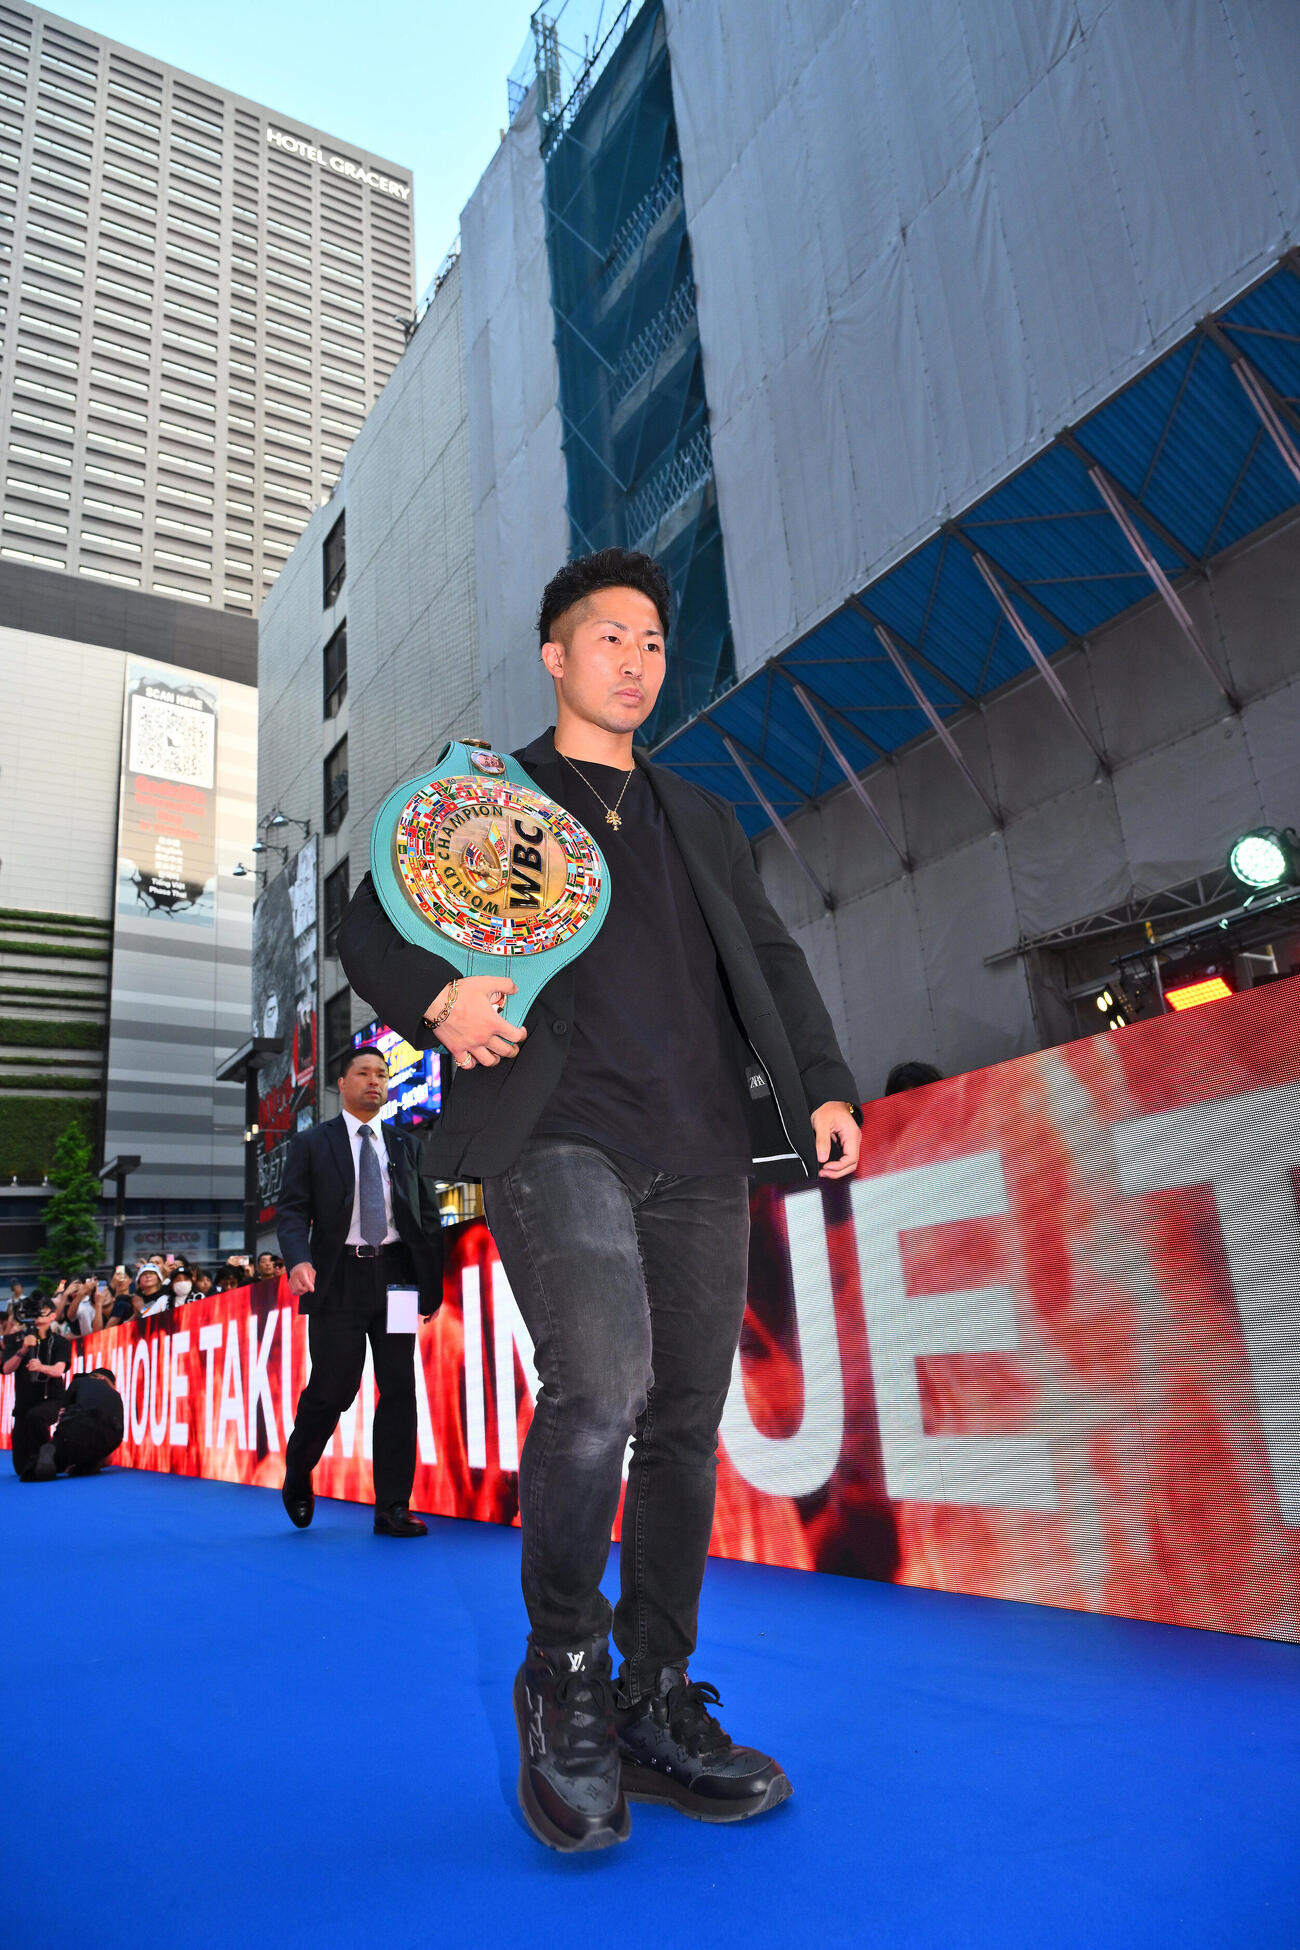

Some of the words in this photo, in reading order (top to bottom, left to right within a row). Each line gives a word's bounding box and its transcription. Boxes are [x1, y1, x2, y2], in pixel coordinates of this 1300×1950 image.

[267, 128, 328, 166] HOTEL
[329, 156, 410, 200] GRACERY
[145, 686, 175, 704] SCAN
[437, 805, 504, 861] CHAMPION
[509, 819, 544, 910] WBC
[444, 866, 499, 915] WORLD
[462, 1149, 1060, 1510] INUE
